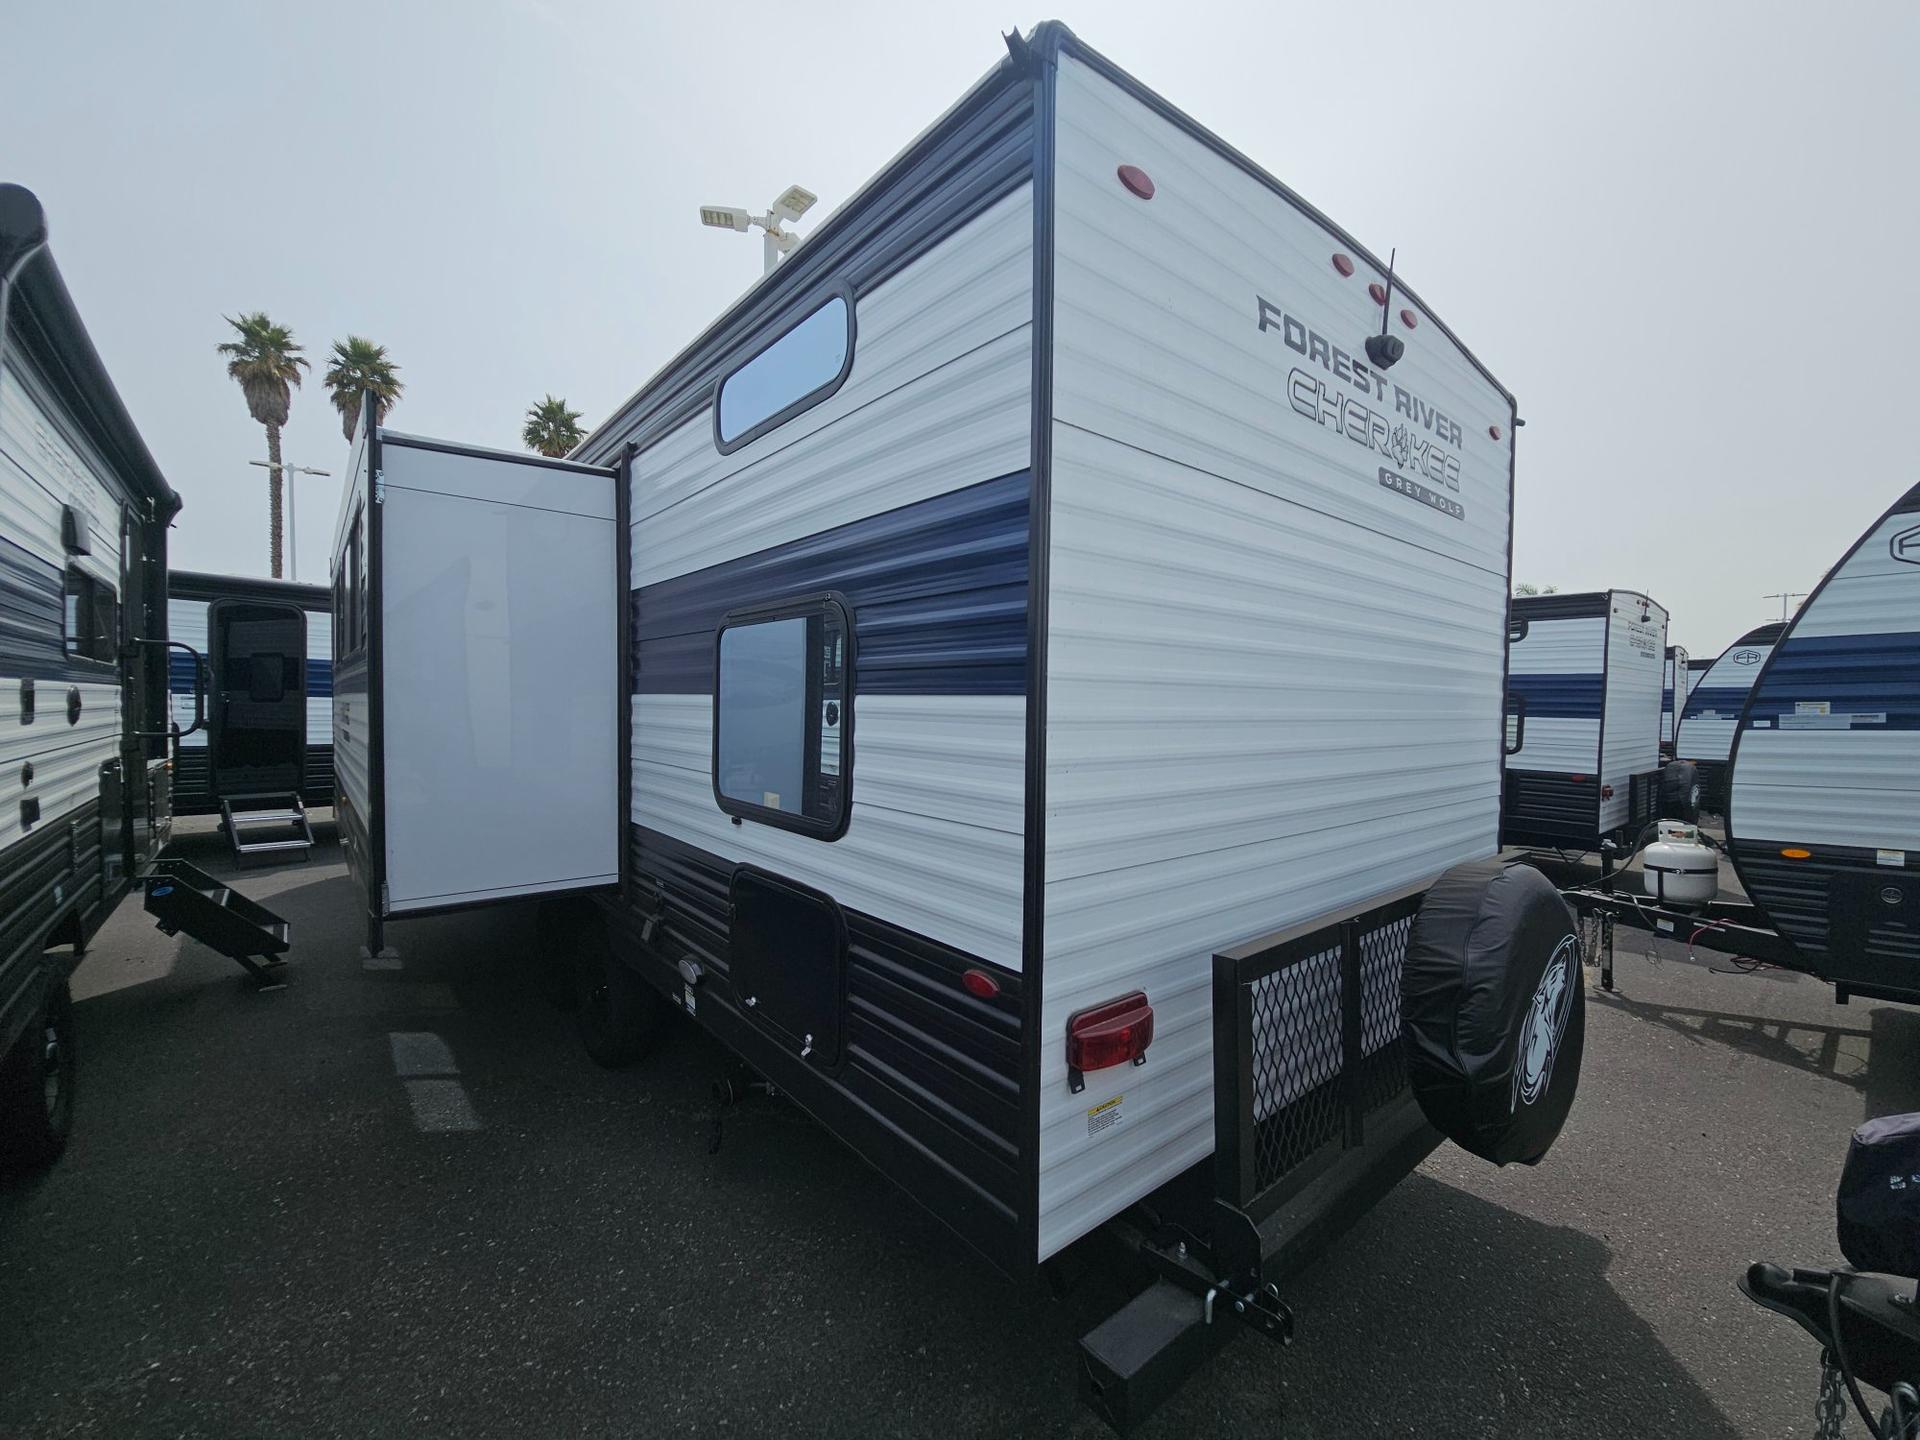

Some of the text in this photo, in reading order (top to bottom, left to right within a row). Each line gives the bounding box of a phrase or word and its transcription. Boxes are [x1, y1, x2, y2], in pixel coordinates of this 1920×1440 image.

[1256, 295, 1463, 450] FOREST RIVER
[1384, 472, 1461, 515] GREY WOLF
